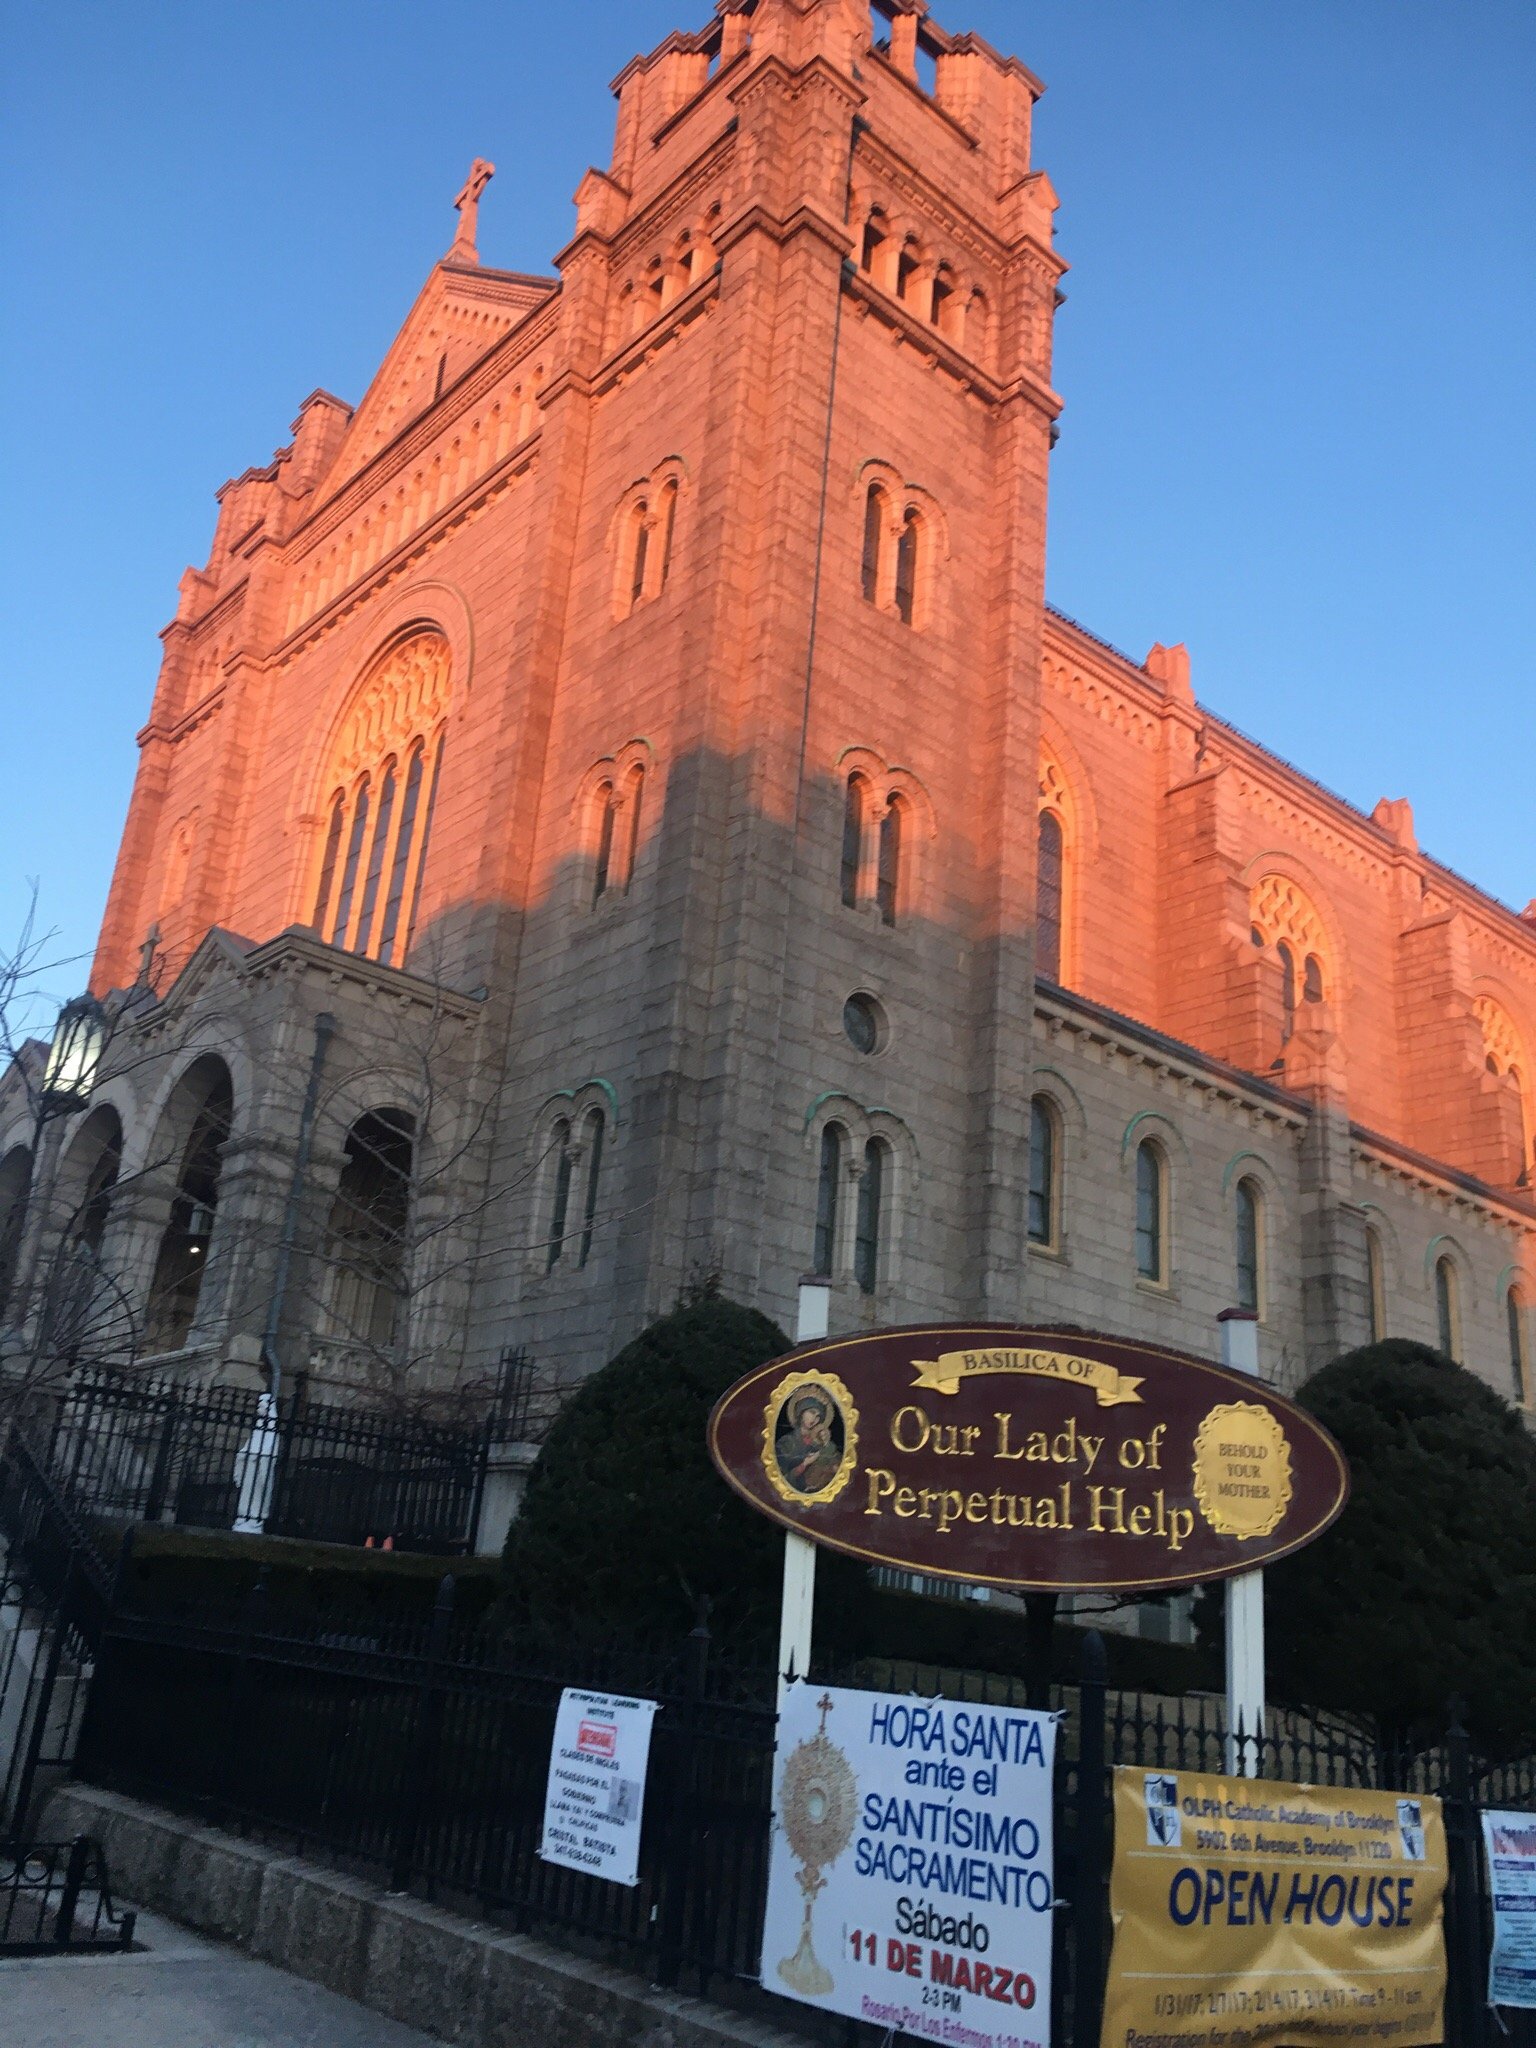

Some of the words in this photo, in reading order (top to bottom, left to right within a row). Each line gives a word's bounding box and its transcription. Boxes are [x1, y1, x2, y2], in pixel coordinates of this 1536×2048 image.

[961, 1353, 1059, 1372] BASILICA
[1066, 1360, 1096, 1378] OF
[890, 1406, 981, 1456] Our
[993, 1412, 1105, 1475] Lady
[1118, 1422, 1168, 1470] of
[1218, 1443, 1269, 1459] BEHOLD
[1218, 1482, 1271, 1499] MOTHER
[1227, 1463, 1262, 1478] YOUR
[864, 1467, 1075, 1533] Perpetual
[1086, 1485, 1195, 1551] Help
[869, 1702, 948, 1754] HORA
[950, 1712, 1046, 1768] SANTA
[905, 1757, 965, 1792] ante
[973, 1763, 998, 1797] el
[863, 1793, 1040, 1860] SANTÍSIMO
[1225, 1800, 1275, 1822] Catholic
[1279, 1805, 1331, 1832] Academy
[1347, 1810, 1394, 1836] Brooklyn
[1304, 1836, 1356, 1862] Brooklyn
[855, 1837, 1052, 1913] SACRAMENTO
[1169, 1866, 1279, 1927] OPEN
[1283, 1872, 1415, 1928] HOUSE
[895, 1896, 989, 1953] Sábado
[850, 1928, 877, 1966] 11
[887, 1937, 923, 1979] DE
[930, 1949, 1037, 2010] MARZO
[921, 1985, 940, 2008] 2-3
[942, 1991, 962, 2014] PM
